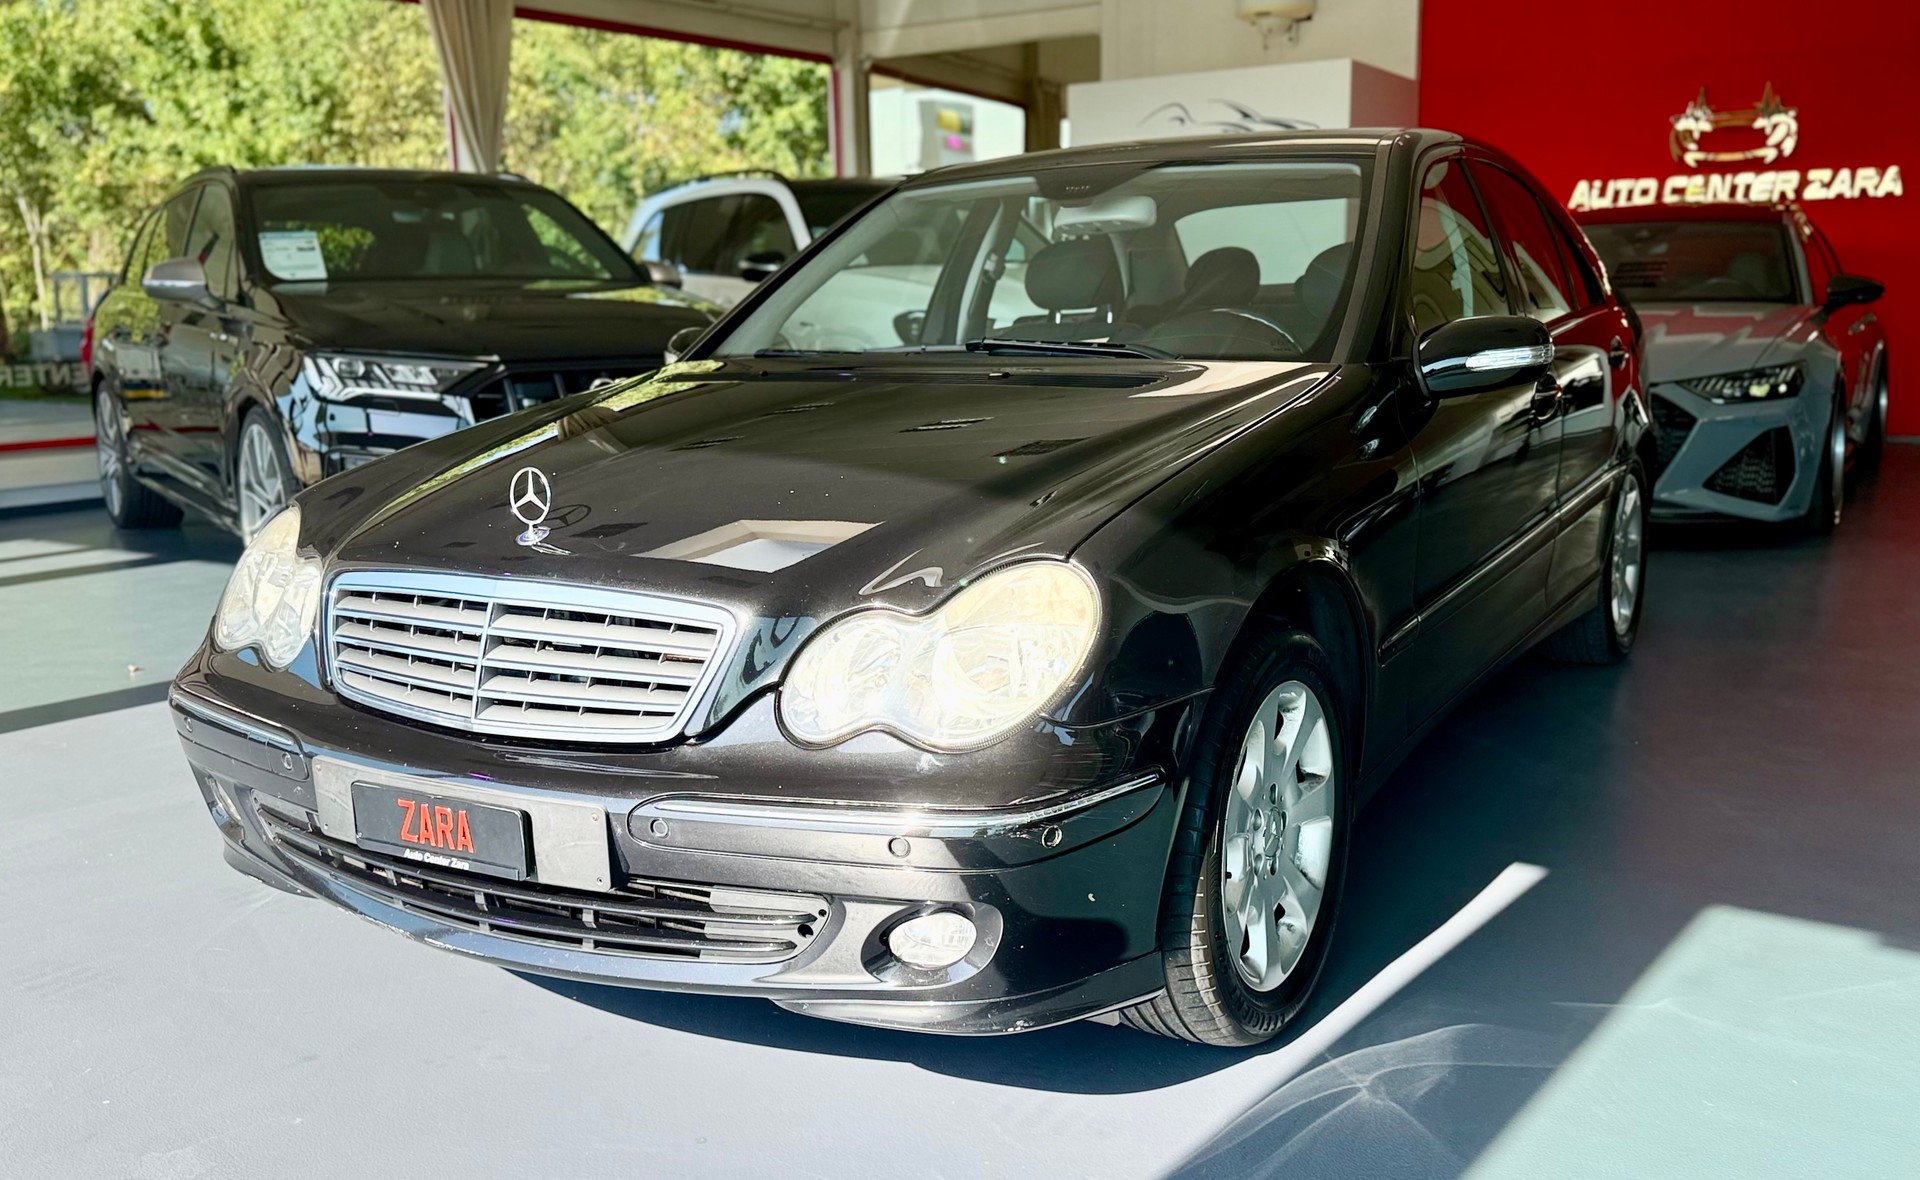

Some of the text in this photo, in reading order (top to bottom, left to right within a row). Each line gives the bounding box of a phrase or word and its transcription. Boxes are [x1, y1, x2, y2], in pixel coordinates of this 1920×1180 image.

[1567, 165, 1903, 212] AUTO CENTER ZARA
[398, 798, 474, 854] ZARA
[403, 847, 470, 870] Auto Center Zara
